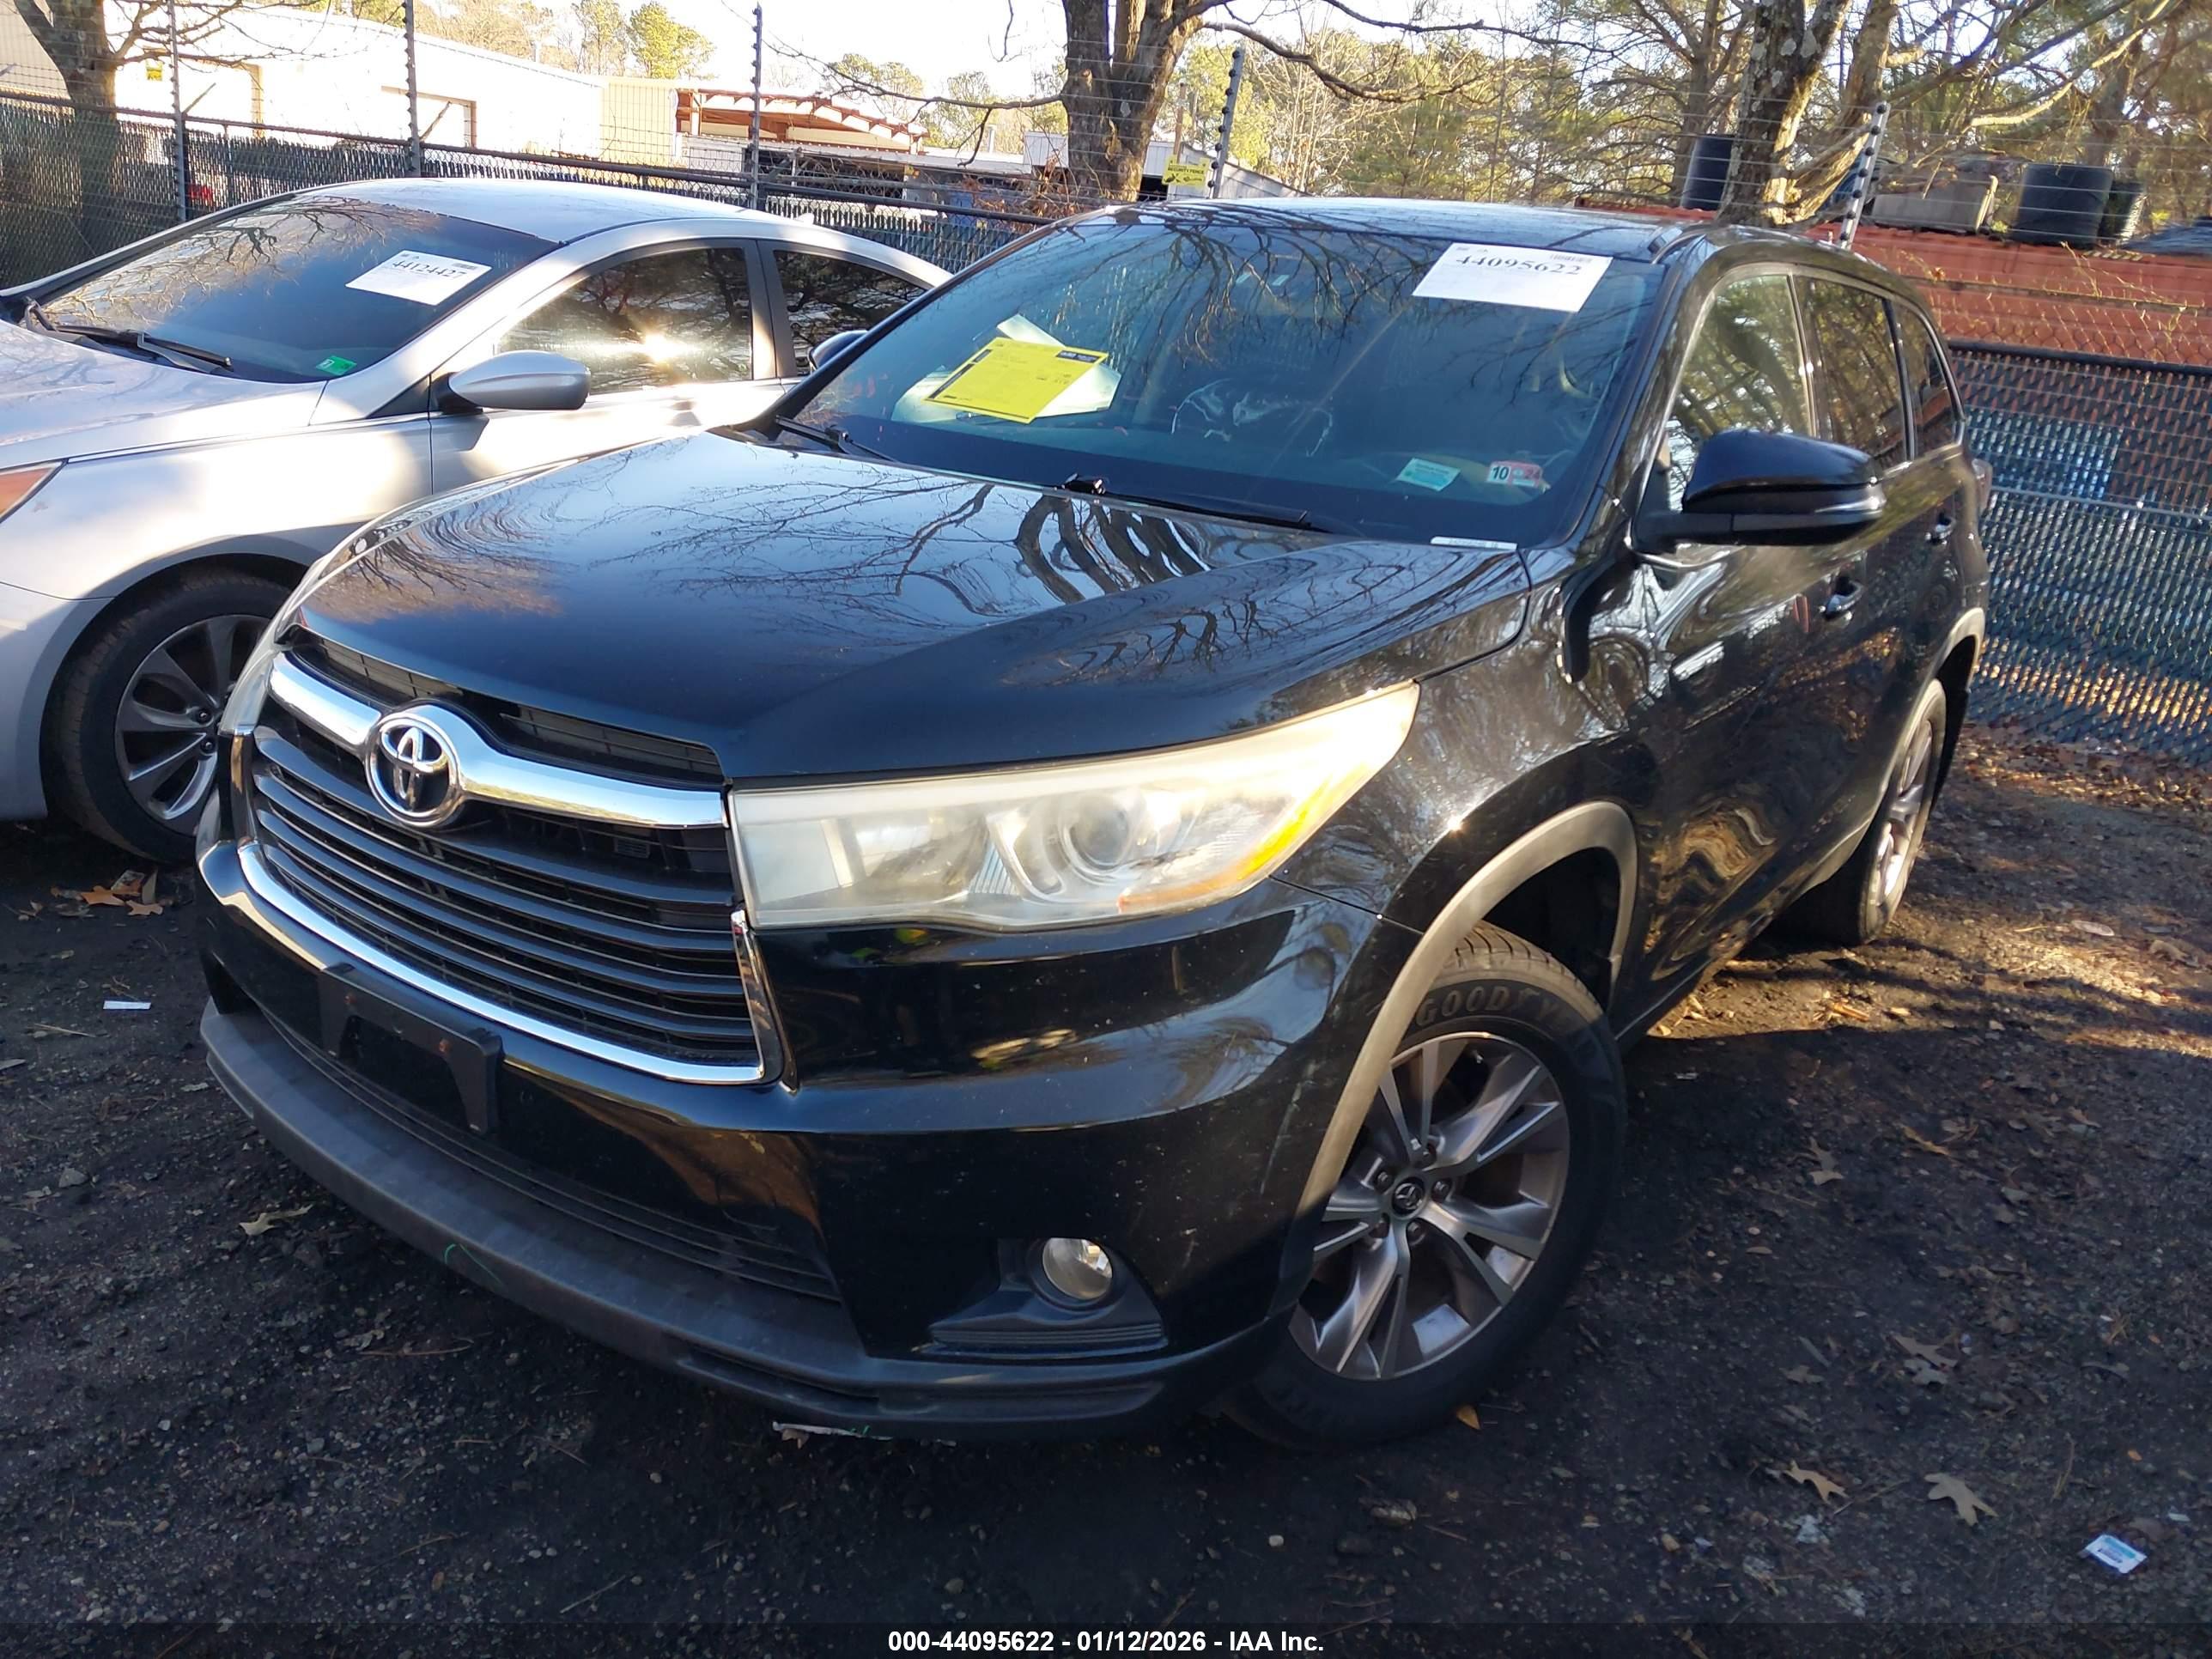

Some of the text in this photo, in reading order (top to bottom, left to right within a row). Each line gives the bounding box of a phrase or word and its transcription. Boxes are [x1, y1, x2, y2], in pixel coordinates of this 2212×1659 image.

[392, 260, 468, 279] 44124427
[1455, 254, 1583, 276] 44095622
[1493, 466, 1510, 480] 10
